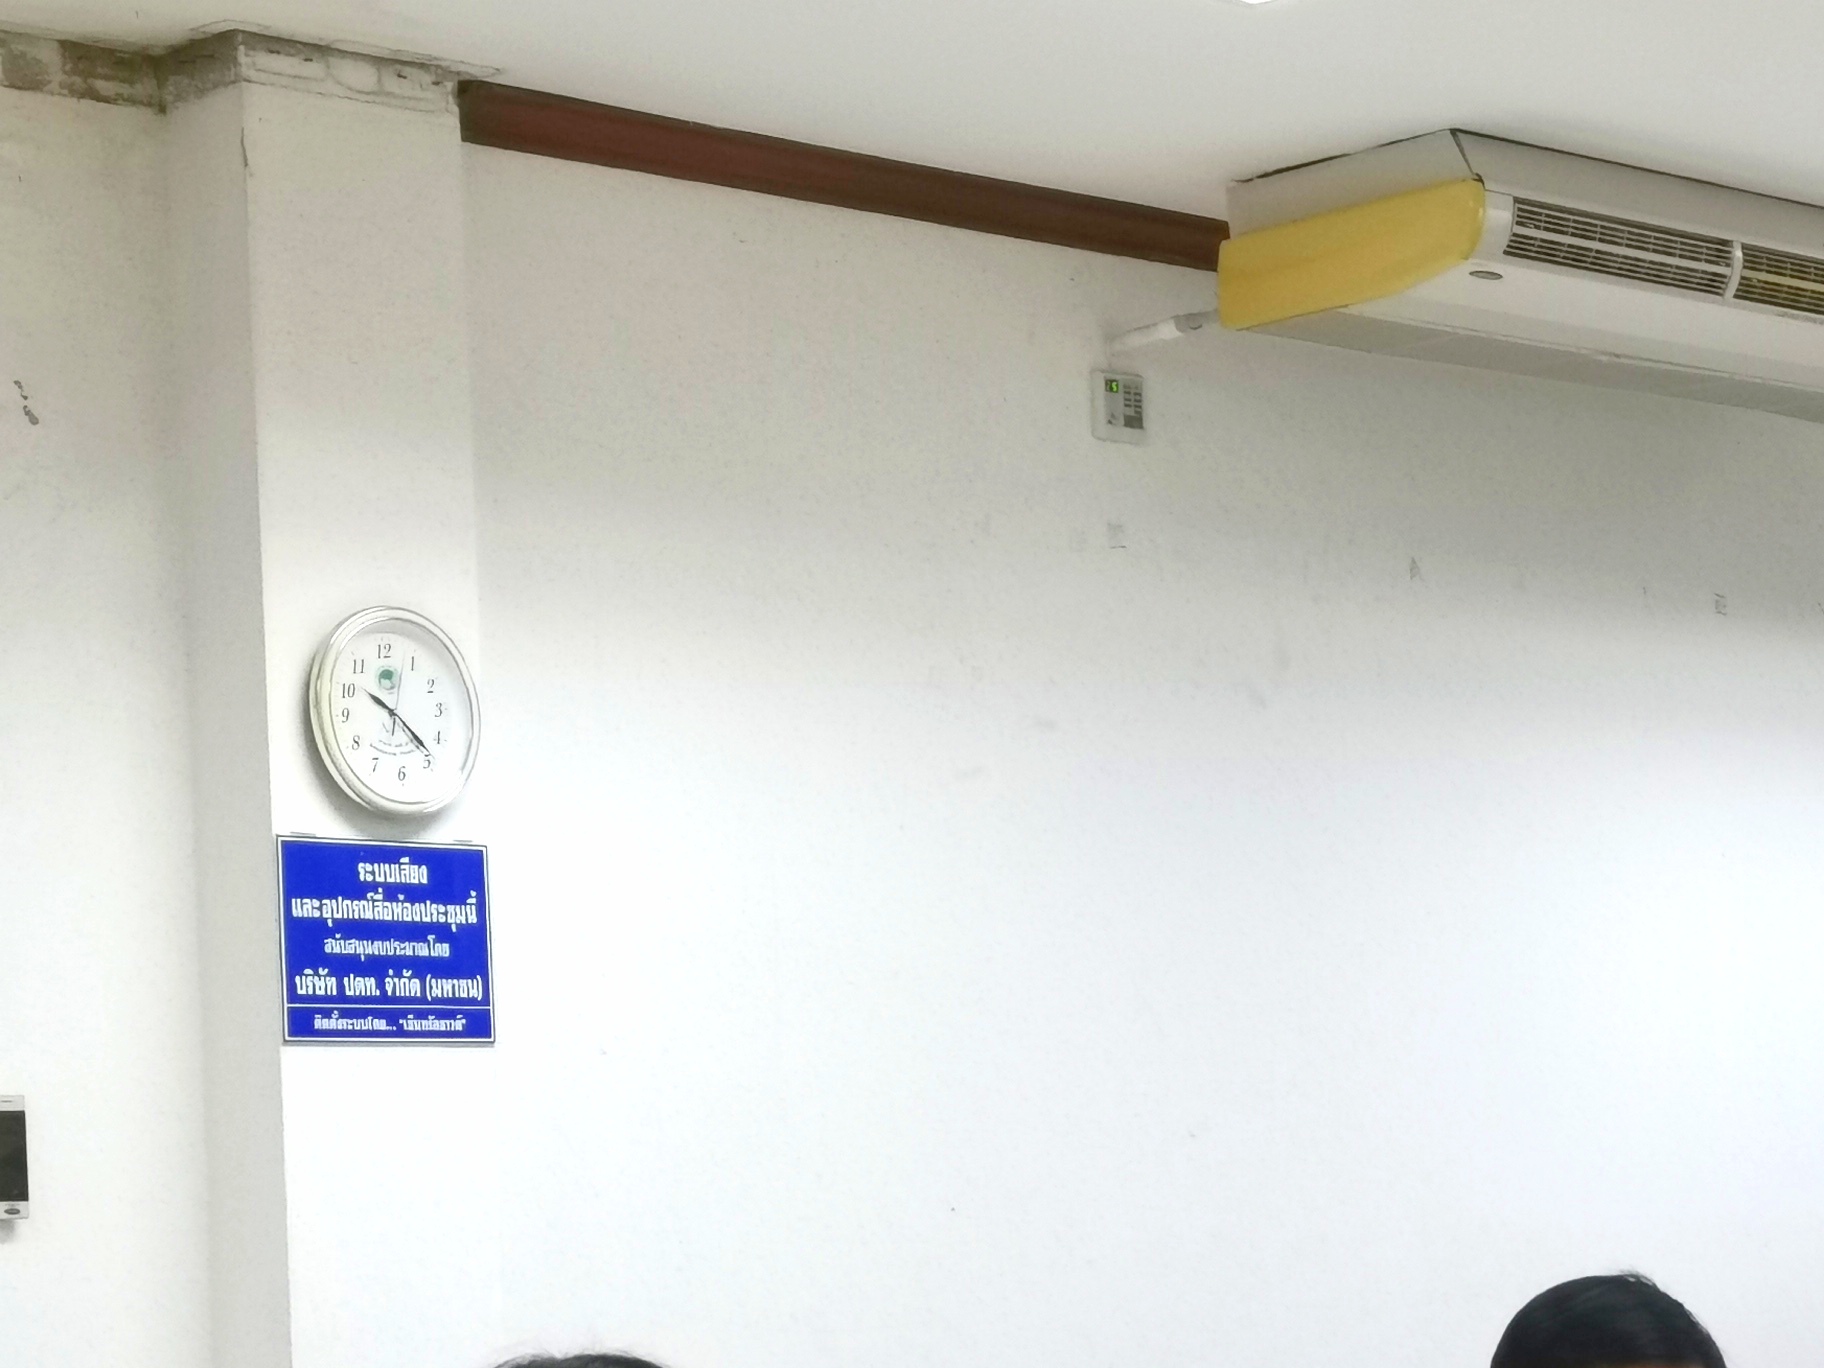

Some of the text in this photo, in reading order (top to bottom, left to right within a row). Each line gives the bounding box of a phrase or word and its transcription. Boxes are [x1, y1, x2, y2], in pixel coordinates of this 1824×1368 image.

[377, 643, 392, 659] 12
[353, 659, 365, 674] 11
[410, 656, 415, 671] 1
[342, 683, 356, 699] 10
[427, 678, 435, 694] 2
[341, 707, 350, 724] 9
[434, 702, 443, 718] 3
[352, 735, 361, 751] 8
[433, 730, 443, 745] 4
[372, 757, 379, 773] 7
[423, 753, 432, 769] 5
[397, 766, 406, 781] 6
[357, 857, 428, 884] ระบบเสียง
[295, 967, 337, 996] บริษัท
[385, 968, 421, 998] จำกัด
[426, 974, 483, 1001] (มหาชน)
